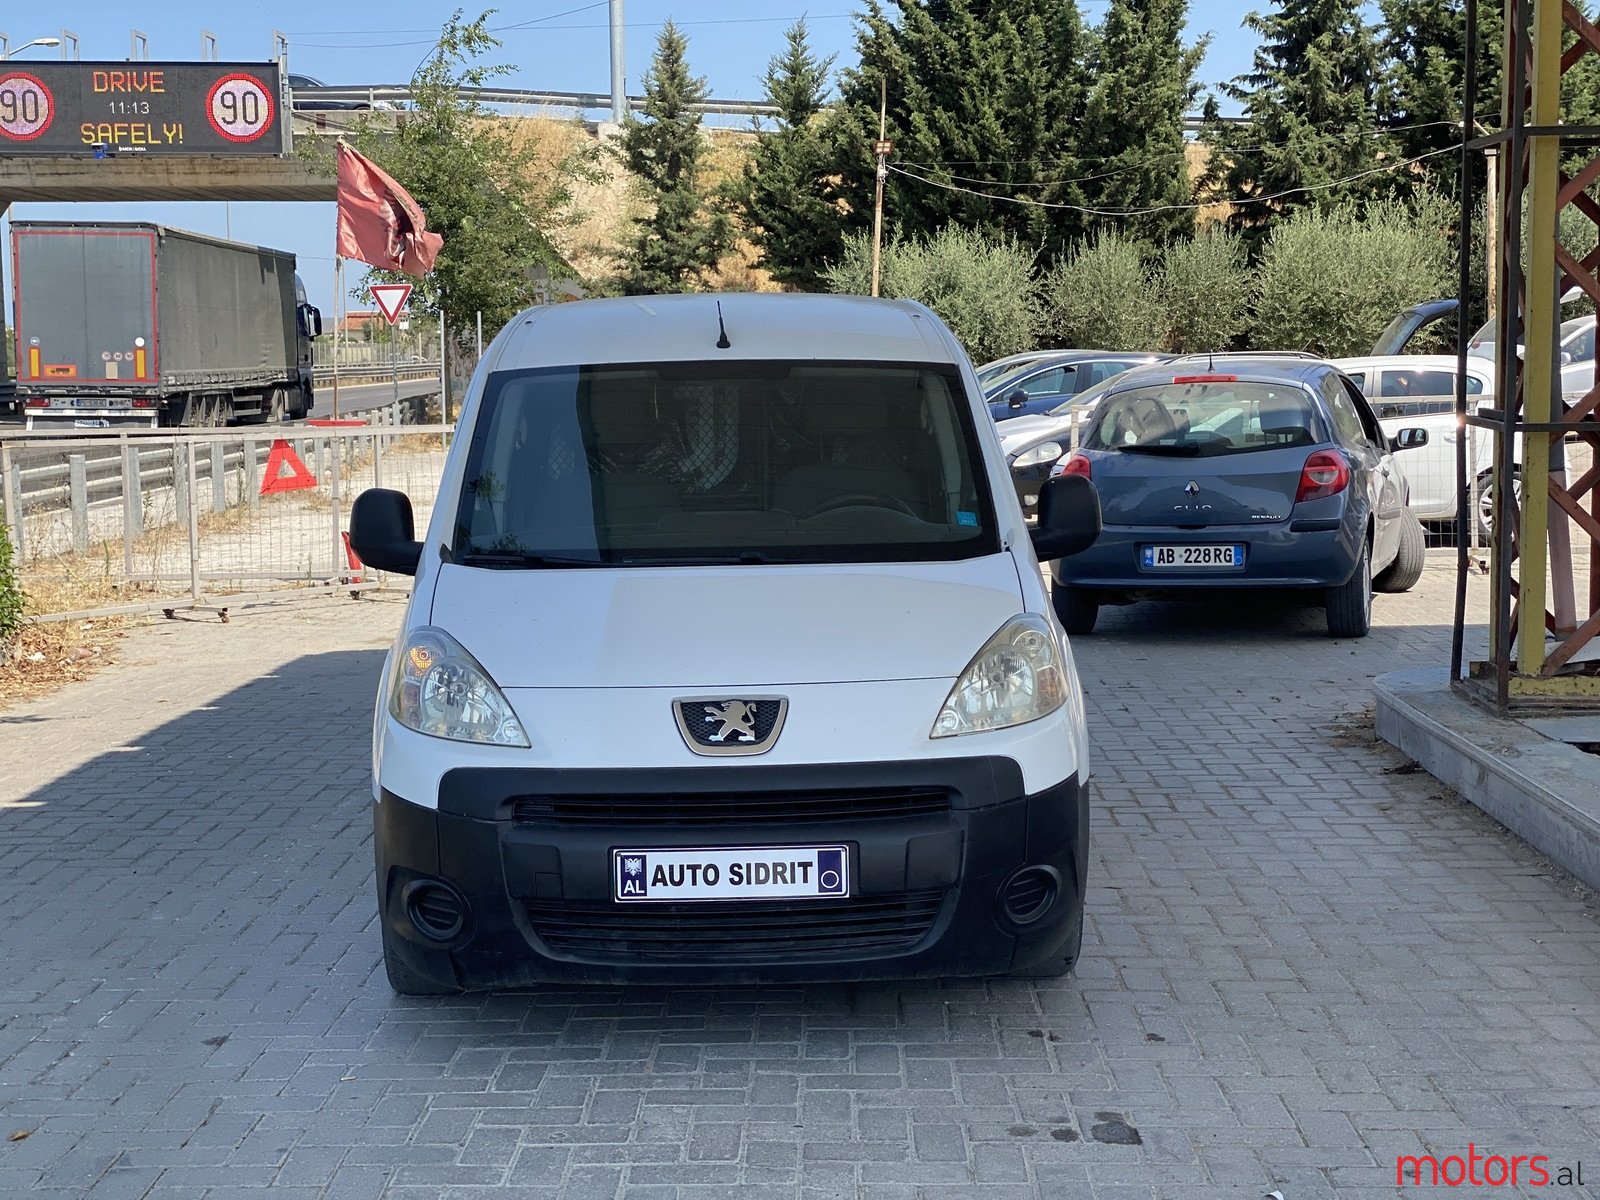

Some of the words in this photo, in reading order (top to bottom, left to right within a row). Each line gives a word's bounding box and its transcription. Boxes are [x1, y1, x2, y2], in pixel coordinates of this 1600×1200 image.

[92, 71, 165, 93] DRIVE
[0, 89, 40, 124] 90
[109, 101, 150, 115] 11:13
[220, 90, 260, 126] 90
[80, 123, 184, 144] SAFELY!
[1157, 548, 1175, 564] AB
[650, 863, 721, 887] AUTO
[728, 861, 814, 886] SIDRIT
[623, 879, 645, 894] AL
